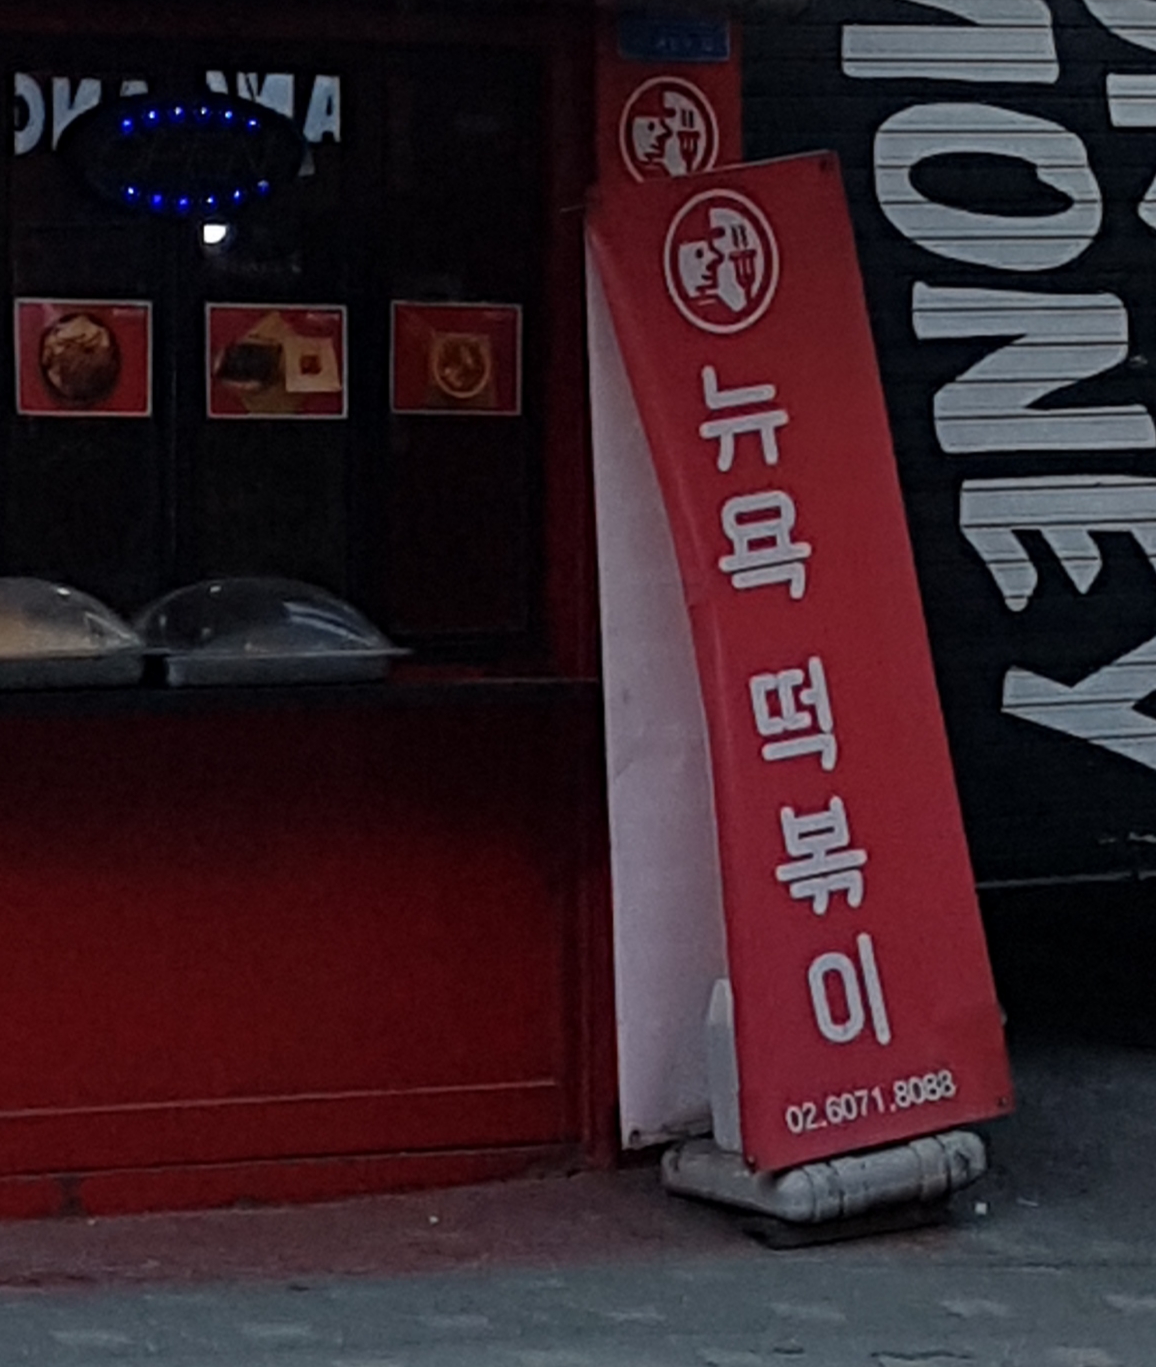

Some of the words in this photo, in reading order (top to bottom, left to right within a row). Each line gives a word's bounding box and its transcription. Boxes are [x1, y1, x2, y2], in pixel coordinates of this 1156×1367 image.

[699, 365, 812, 600] 뉴욕
[747, 655, 891, 1046] 떡볶이
[784, 1069, 957, 1134] 02.6071.8088
